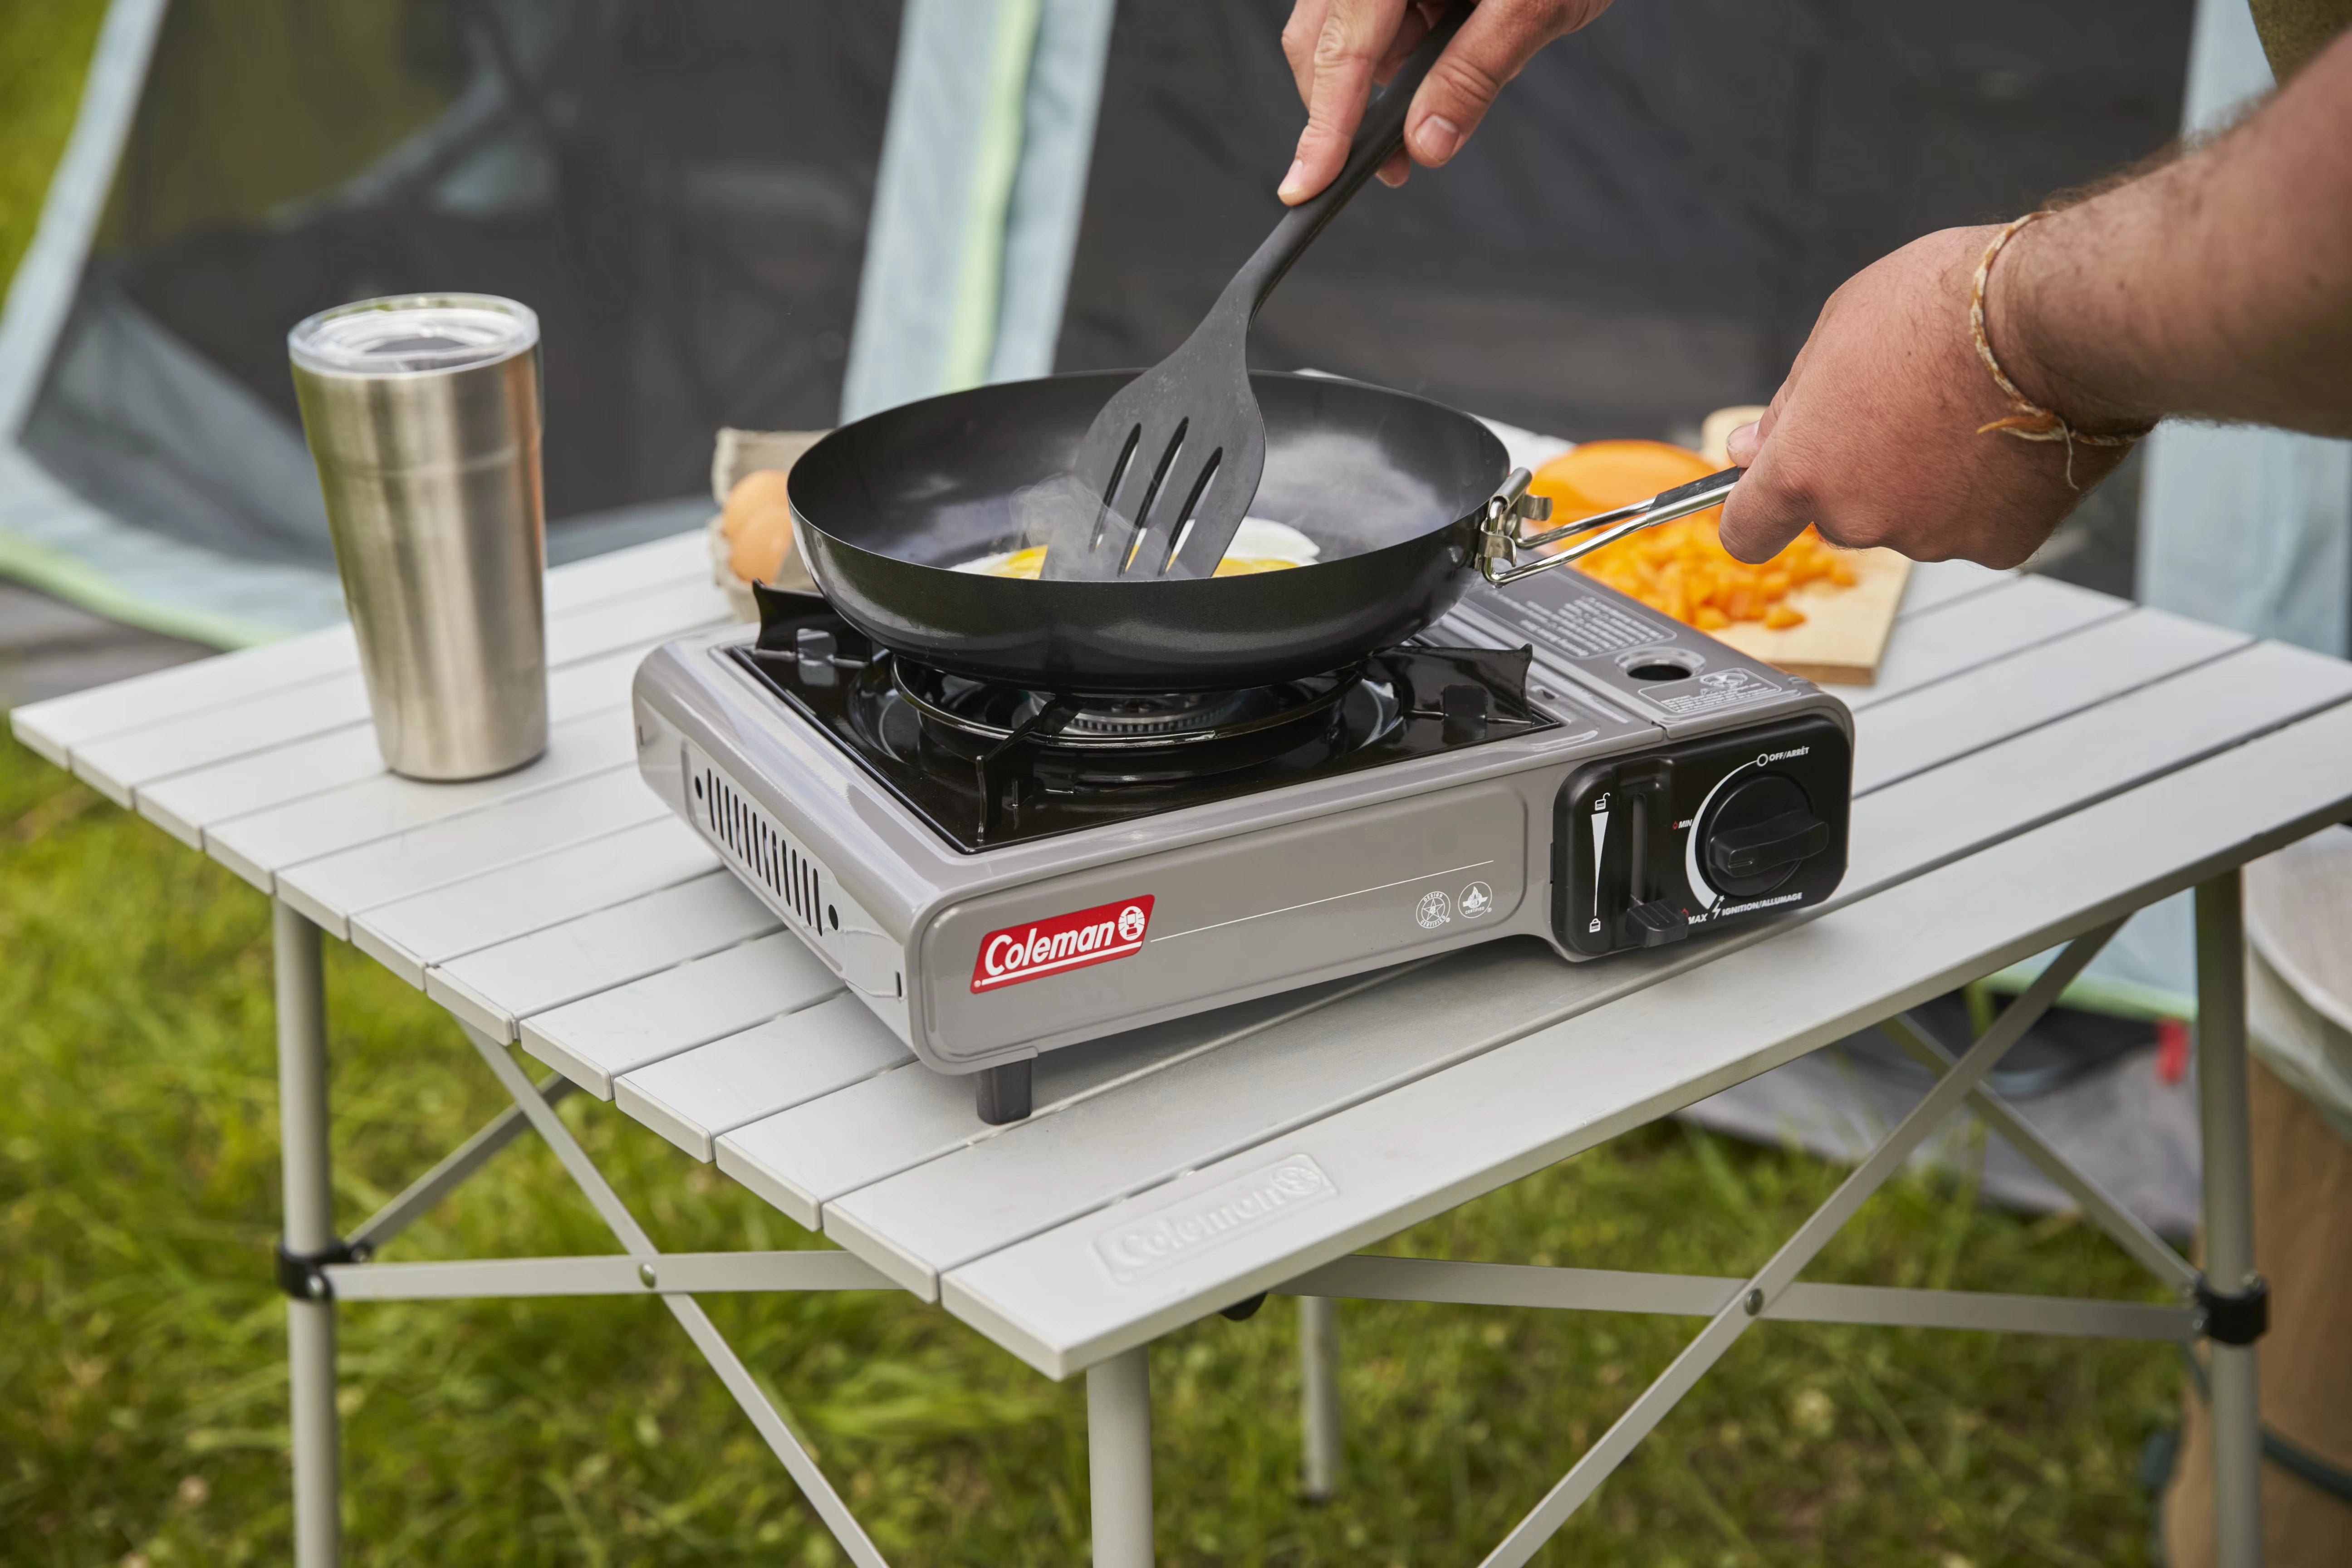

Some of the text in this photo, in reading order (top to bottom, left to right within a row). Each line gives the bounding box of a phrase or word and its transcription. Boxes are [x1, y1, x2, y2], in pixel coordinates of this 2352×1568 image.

[1769, 746, 1810, 762] OFF/ARRÊT
[1678, 818, 1693, 829] MIN
[1423, 892, 1443, 902] DESIGN
[1721, 892, 1803, 916] IGNITION/ALLUMAGE
[1465, 906, 1485, 915] CERTIFIED
[1420, 915, 1446, 927] CERTIFIED
[1688, 913, 1708, 925] MAX
[985, 921, 1116, 976] Coleman
